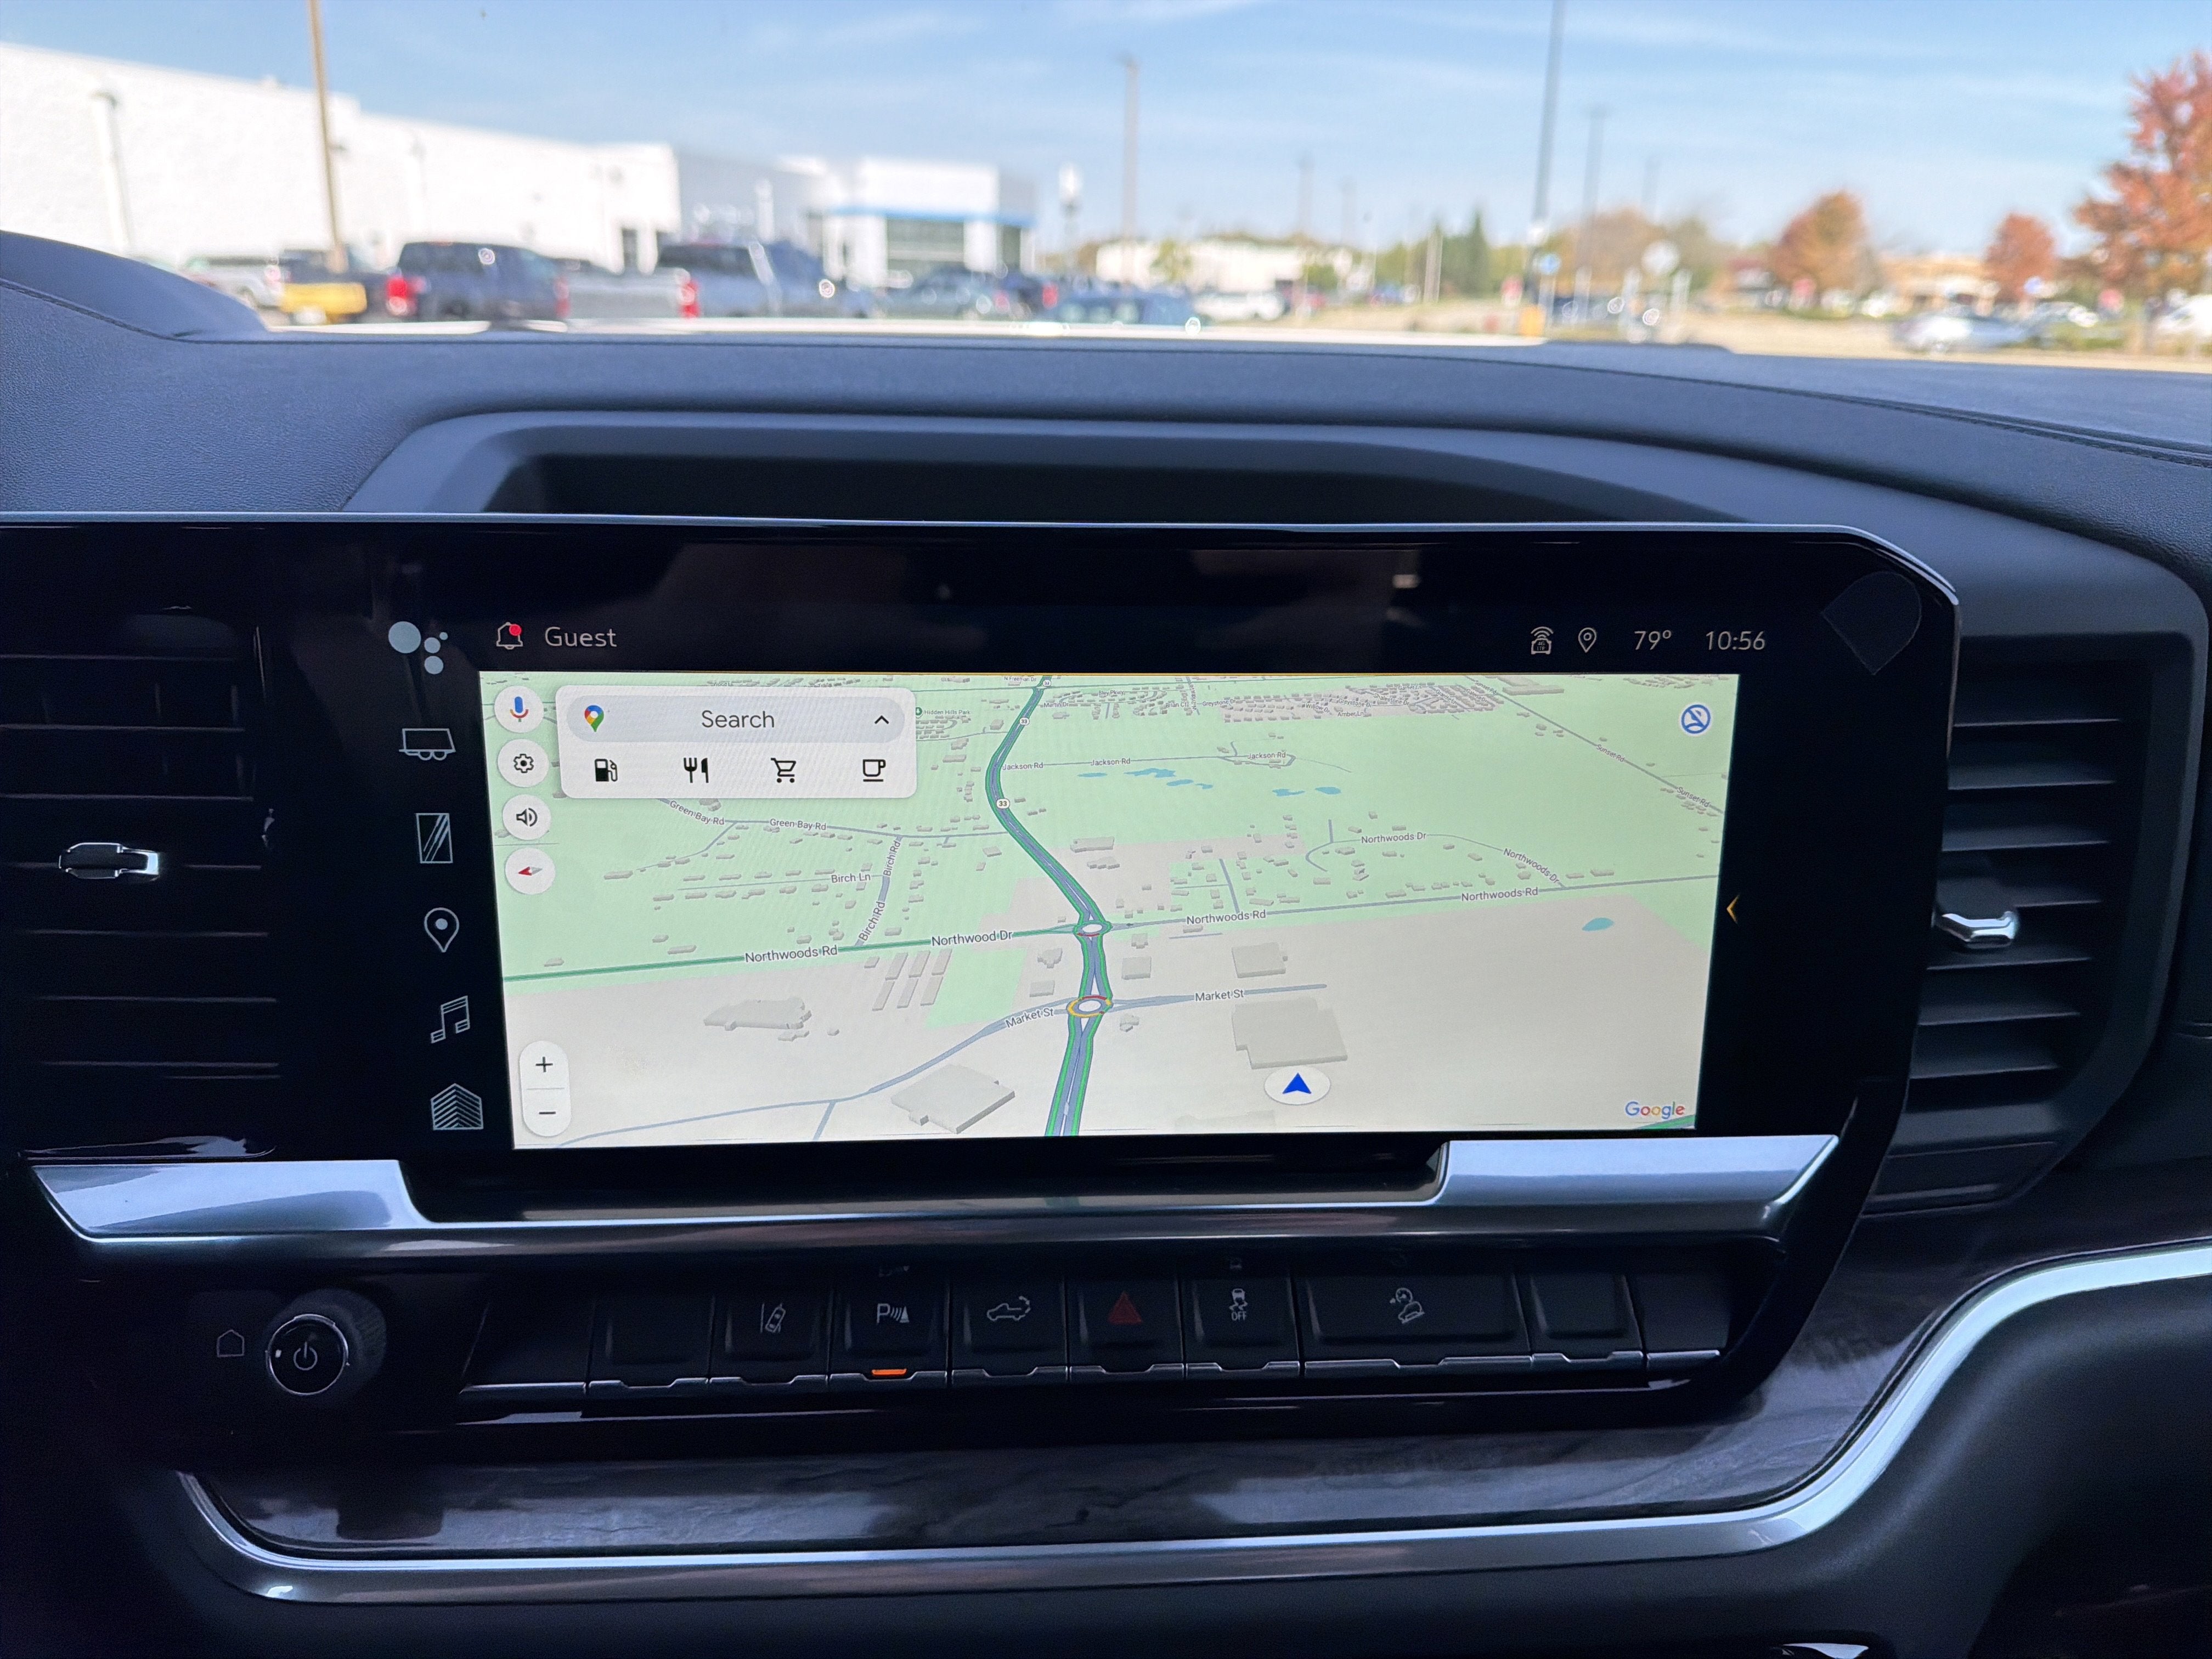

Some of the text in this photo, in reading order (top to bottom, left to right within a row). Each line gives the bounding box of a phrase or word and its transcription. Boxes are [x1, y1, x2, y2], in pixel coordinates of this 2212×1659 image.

[545, 627, 617, 647] Guest
[1706, 631, 1766, 651] 10:56
[1475, 680, 1497, 695] Sunset Rd
[1373, 693, 1402, 705] Shalestone
[701, 709, 775, 729] Search
[1596, 744, 1625, 763] Sunset Rd
[1677, 786, 1710, 808] Sunset Rd
[670, 800, 694, 817] Green
[695, 812, 711, 825] Bay
[770, 819, 826, 831] Green Bay Rd
[1361, 832, 1427, 844] Northwoods Dr
[883, 840, 901, 877] Birch Rd
[1503, 848, 1559, 883] Northwoods Dr
[831, 873, 871, 883] Birch Ln
[1462, 887, 1538, 902] Northwoods Rd
[858, 901, 885, 941] Birch Rd
[1186, 910, 1266, 925] Northwoods Rd
[932, 930, 1013, 947] Northwood Dr
[745, 945, 838, 963] Northwoods Rd
[1194, 989, 1244, 1001] Market St
[1005, 1007, 1054, 1029] Market St
[1625, 1101, 1685, 1119] Google
[1231, 1311, 1246, 1321] OFF
